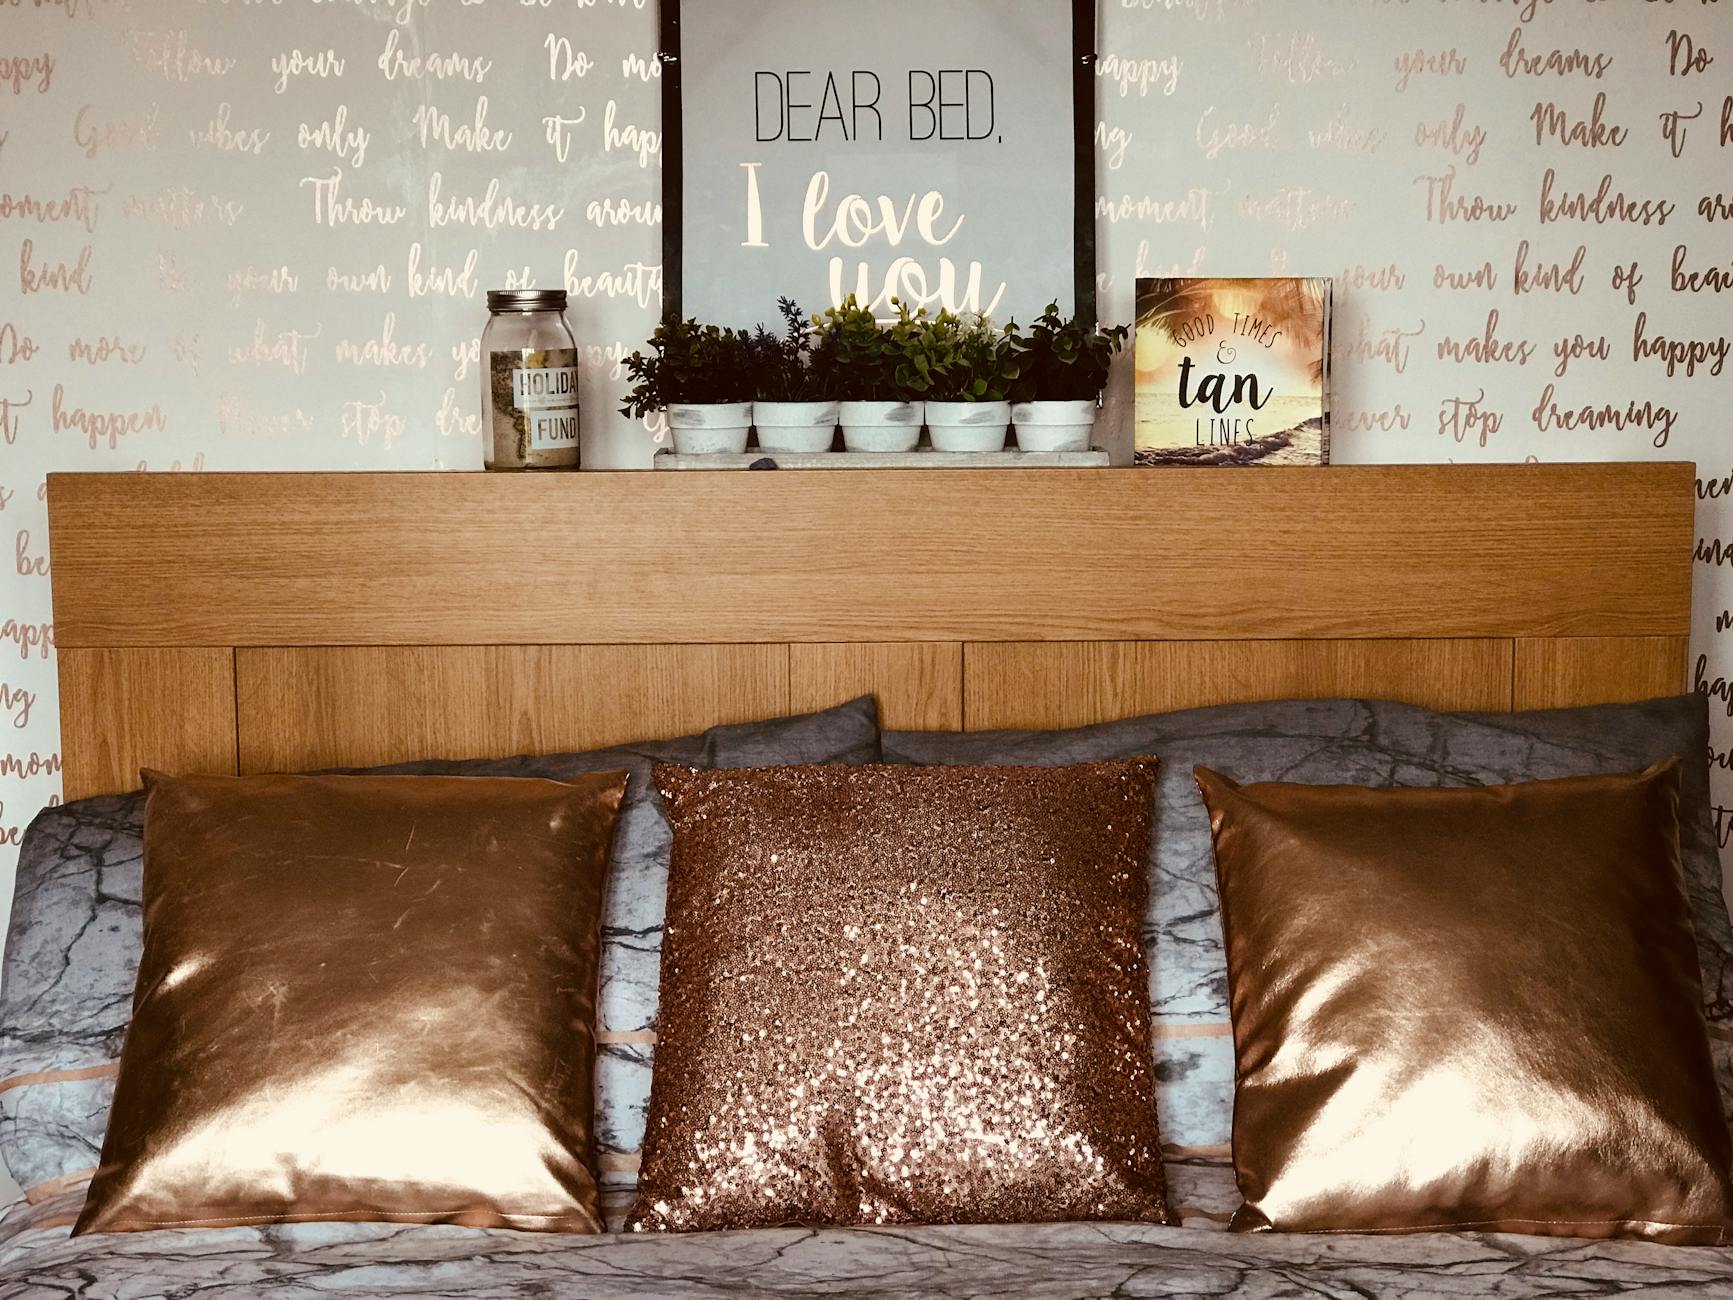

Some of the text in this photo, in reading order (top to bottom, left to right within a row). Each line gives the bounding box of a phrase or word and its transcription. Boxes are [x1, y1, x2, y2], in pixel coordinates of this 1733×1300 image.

[271, 49, 344, 94] your
[378, 28, 492, 83] dreams
[544, 33, 594, 81] Do
[1395, 48, 1467, 93] your
[1500, 27, 1613, 79] dreams
[1665, 29, 1714, 77] Do
[298, 105, 370, 168] only
[412, 96, 512, 152] Make
[542, 106, 586, 163] it
[754, 70, 1002, 143] DEAR BED,
[1415, 103, 1487, 166] only
[1531, 91, 1628, 148] Make
[1659, 101, 1703, 159] it
[299, 167, 406, 227] Throw
[428, 171, 564, 230] kindness
[739, 162, 965, 251] I love
[1413, 164, 1517, 225] Throw
[1539, 168, 1676, 226] kindness
[20, 238, 93, 295] kind
[327, 264, 392, 294] own
[407, 242, 479, 299] kind
[1433, 262, 1498, 291] own
[1514, 239, 1587, 295] kind
[1612, 261, 1643, 306] of
[69, 336, 147, 365] more
[335, 311, 431, 369] makes
[1173, 312, 1283, 350] GOOD TIMES
[1216, 340, 1237, 365] &
[1437, 308, 1537, 366] makes
[1553, 334, 1611, 378] you
[1633, 311, 1731, 378] happy
[52, 383, 168, 450] happen
[340, 390, 407, 450] stop
[1177, 356, 1274, 414] tan
[1438, 387, 1504, 448] stop
[1531, 383, 1679, 448] dreaming
[537, 417, 577, 441] FUND
[1195, 417, 1255, 448] LINES
